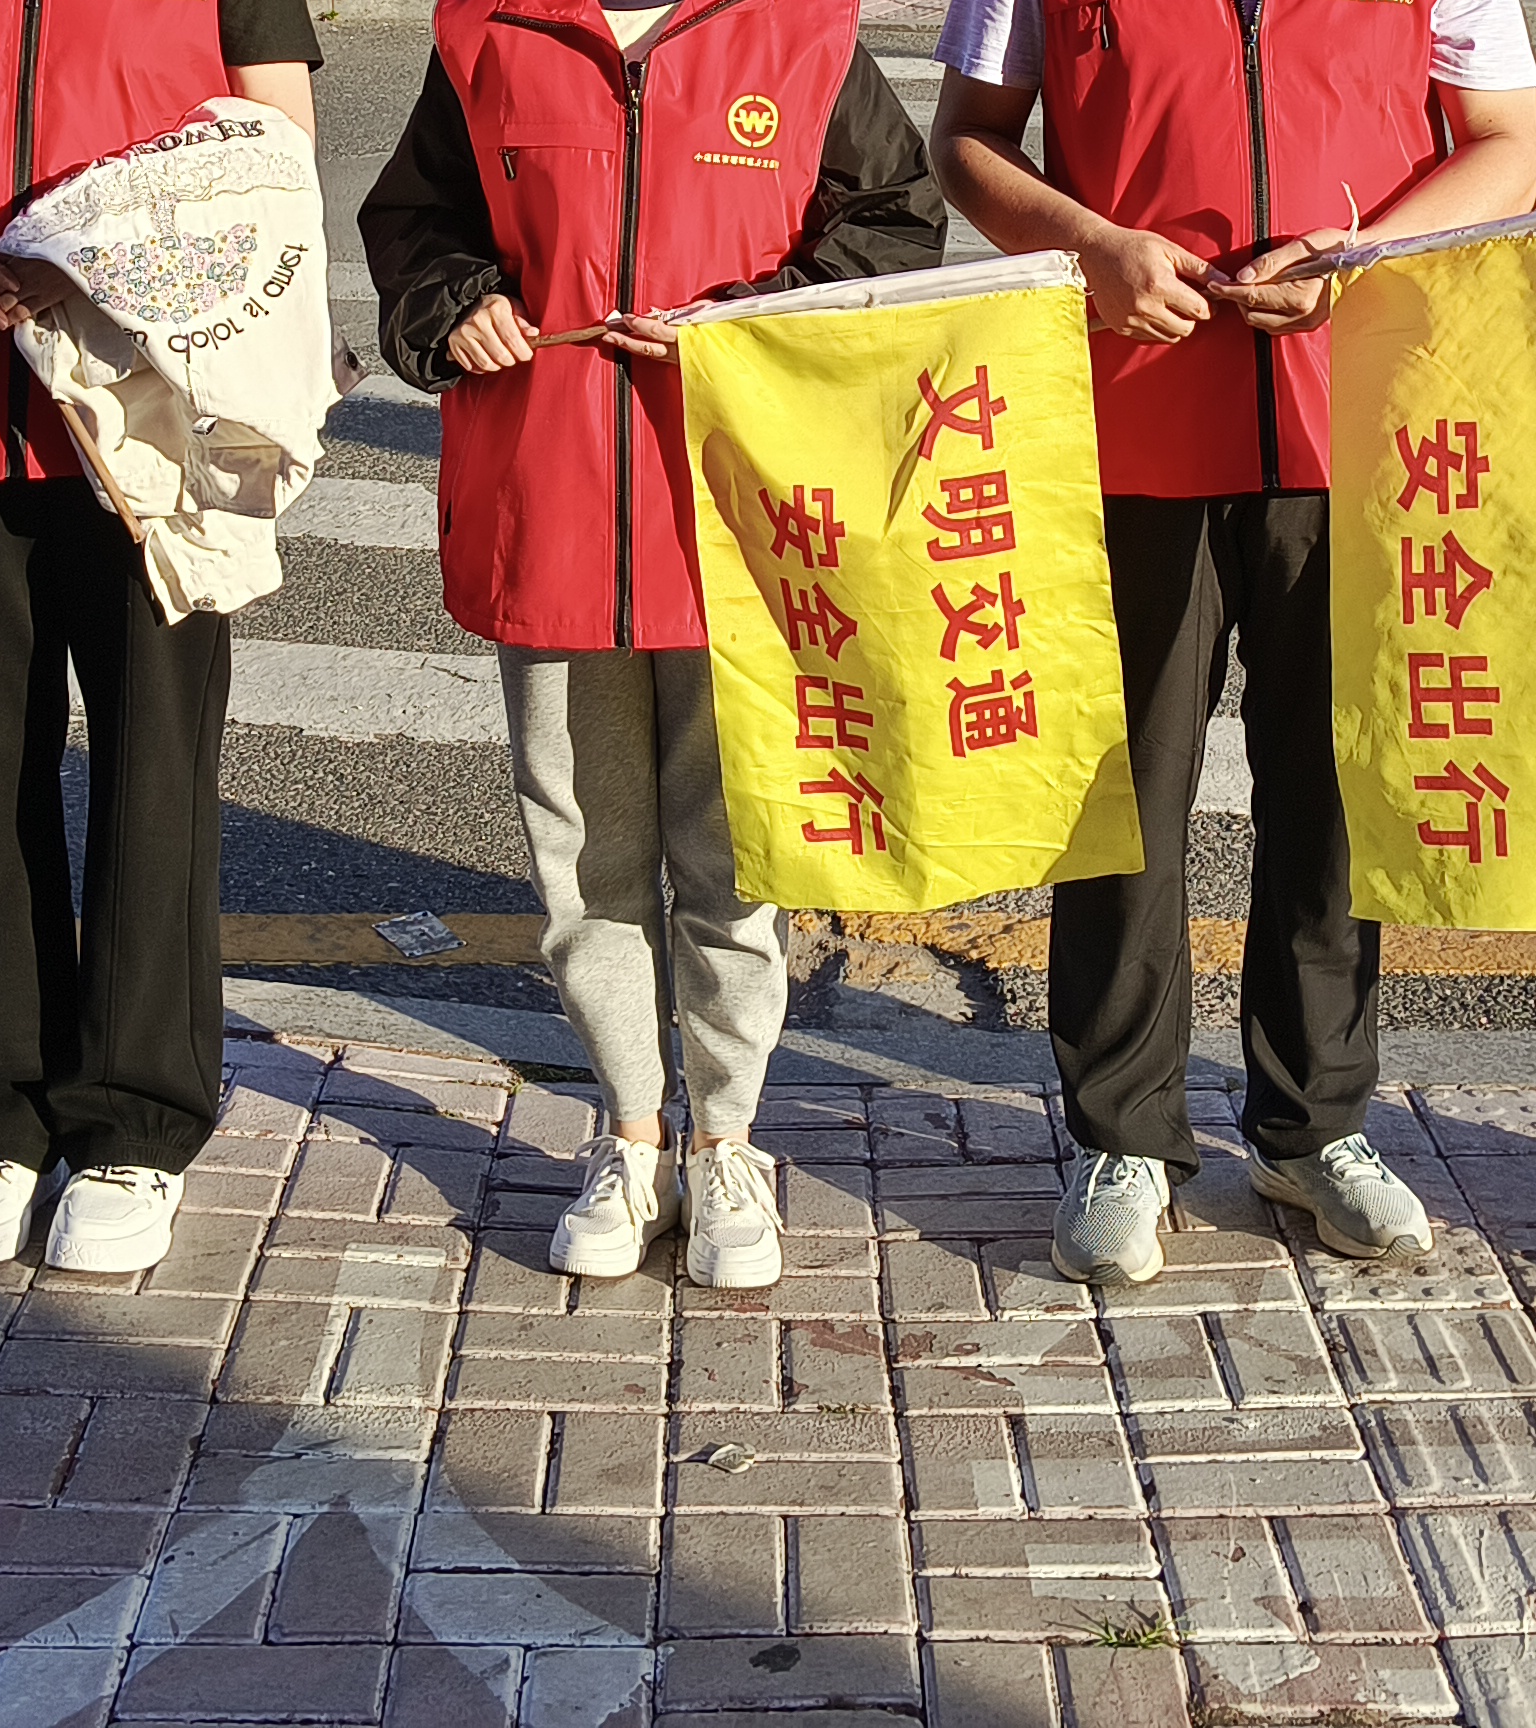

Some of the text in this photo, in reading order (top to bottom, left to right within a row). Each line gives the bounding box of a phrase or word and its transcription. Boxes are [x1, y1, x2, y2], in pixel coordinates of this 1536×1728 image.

[757, 484, 888, 856] 安全出行
[916, 364, 1038, 758] 文明交通
[1393, 418, 1510, 865] 安全出行
